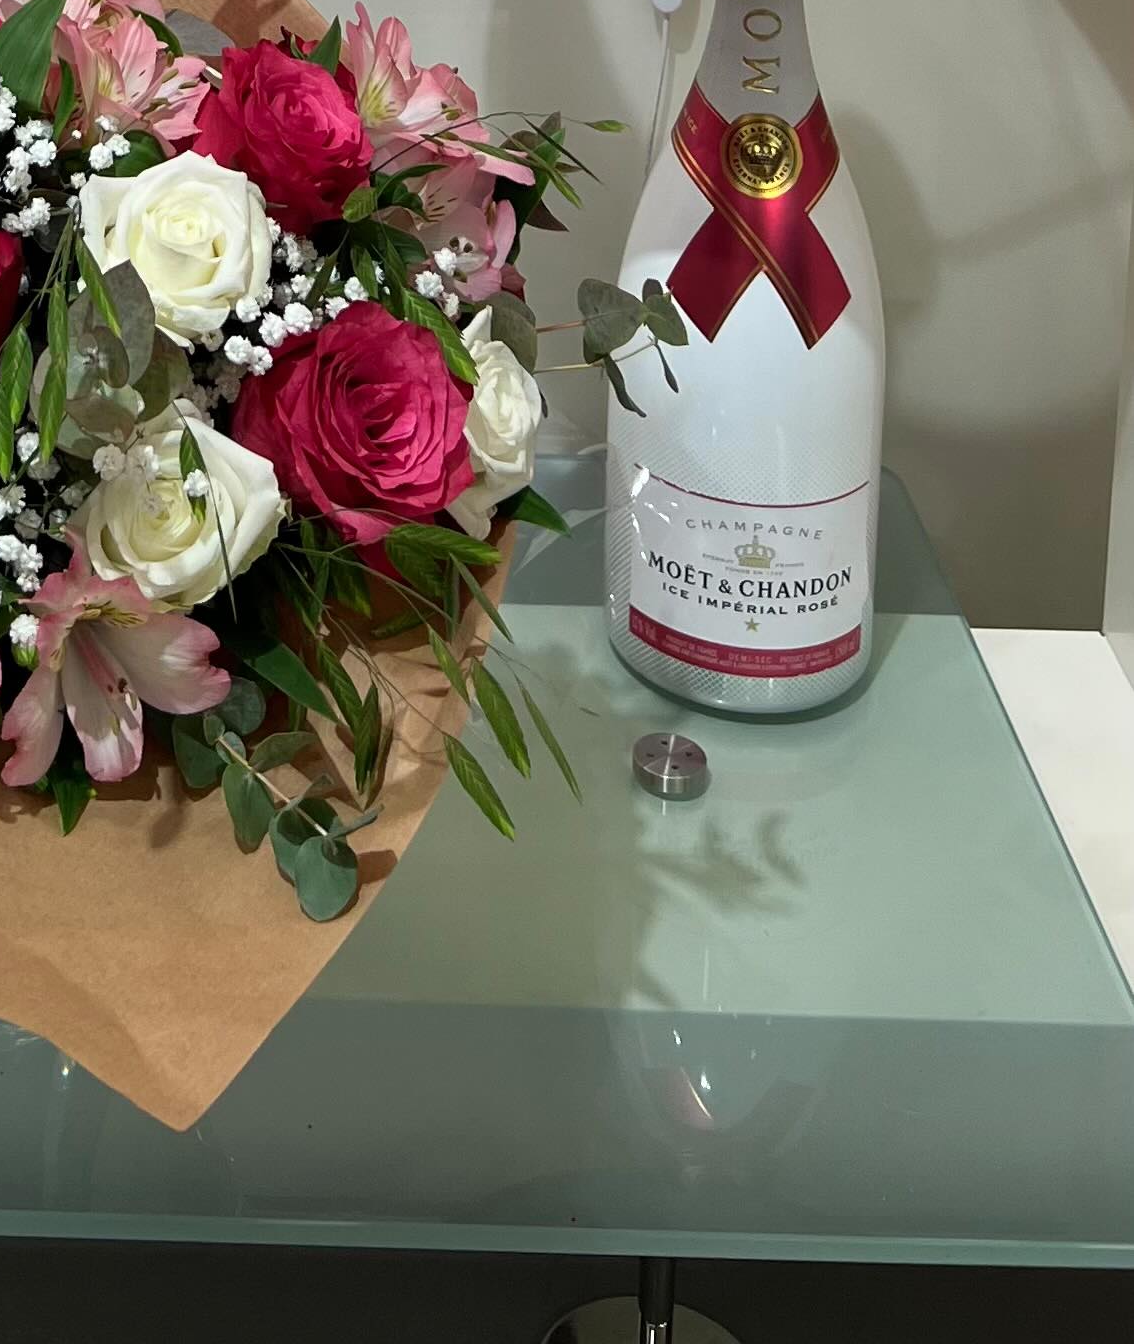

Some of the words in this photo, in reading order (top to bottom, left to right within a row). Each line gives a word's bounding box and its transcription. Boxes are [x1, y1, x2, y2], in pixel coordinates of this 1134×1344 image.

[685, 519, 823, 541] CHAMPAGNE
[648, 550, 713, 590] MOËT
[718, 579, 733, 595] &
[739, 566, 852, 599] CHANDON
[662, 582, 689, 600] ICE
[698, 595, 789, 615] IMPÉRIAL
[797, 594, 839, 613] ROSÉ
